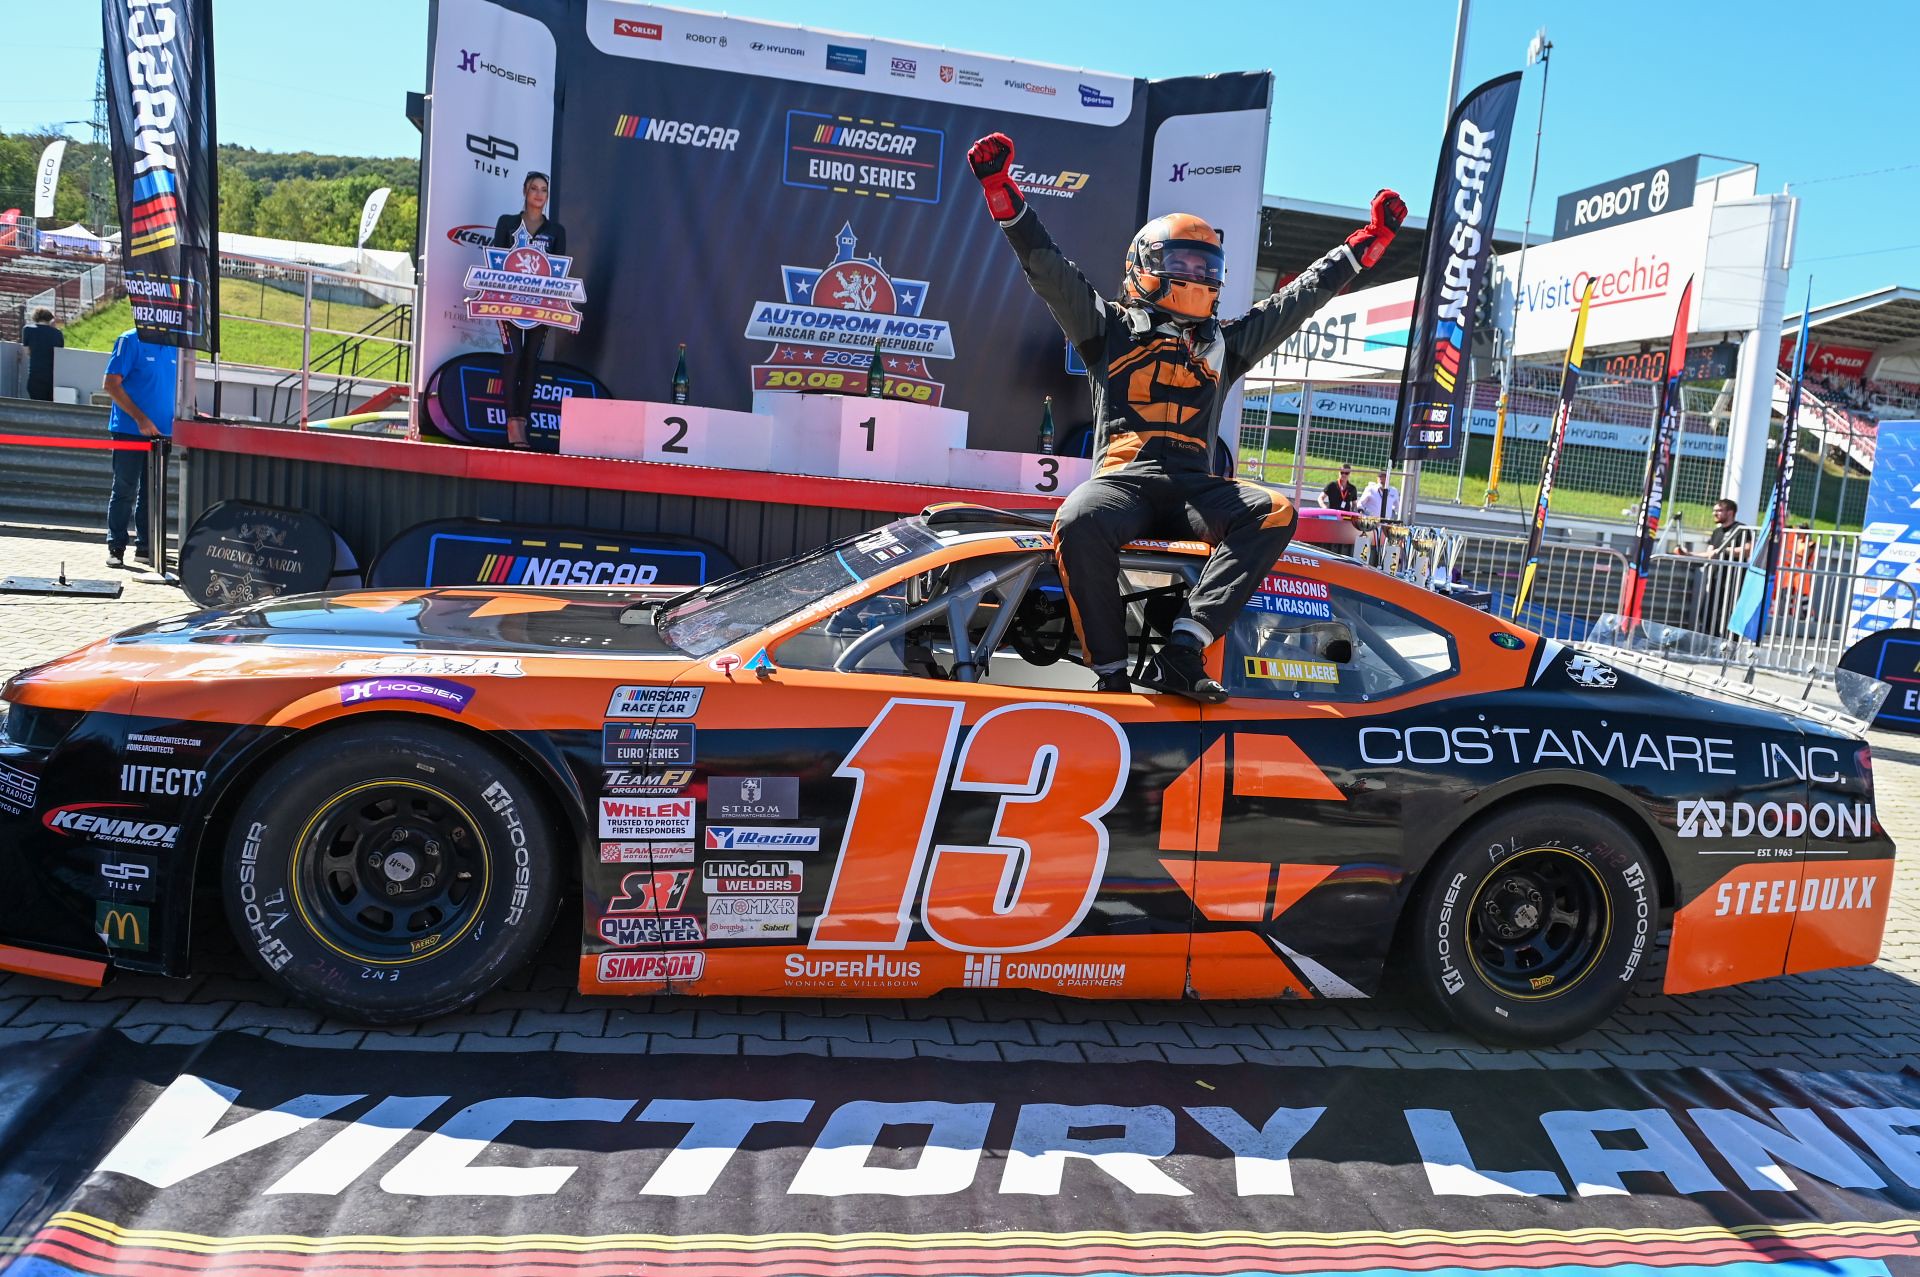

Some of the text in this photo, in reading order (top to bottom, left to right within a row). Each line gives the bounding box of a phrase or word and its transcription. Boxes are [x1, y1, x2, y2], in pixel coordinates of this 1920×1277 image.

[632, 26, 658, 36] ORLEN
[686, 33, 717, 45] ROBOT
[766, 45, 805, 57] HYUNDAI
[480, 61, 537, 87] HOOSIER
[891, 60, 917, 71] NEXEN
[1004, 79, 1057, 94] #VisitCzechia
[645, 118, 740, 151] NASCAR
[838, 128, 917, 155] NASCAR
[474, 159, 509, 179] TIJEY
[809, 159, 916, 191] EURO SERIES
[1188, 165, 1241, 176] HOOSIER
[42, 158, 54, 198] IVECO
[1017, 184, 1074, 199] GANIZATION
[1574, 182, 1645, 227] ROBOT
[1437, 118, 1495, 327] NASCAR
[454, 230, 494, 247] KEN
[473, 270, 579, 291] AUTODROM MOST
[1517, 254, 1670, 313] #VisitCzechia
[478, 281, 506, 290] NASCAR
[519, 285, 540, 293] CZECH
[541, 287, 573, 298] REPUBLIC
[509, 294, 543, 306] 2025
[478, 304, 523, 316] 30.08
[534, 309, 572, 323] 31.08
[756, 306, 946, 341] AUTODROM MOST
[767, 325, 934, 353] NASCAR GP CZECH REPUBLIC
[1835, 357, 1864, 368] ORLEN
[765, 371, 845, 388] 30.08
[533, 383, 573, 400] SCAR
[1339, 402, 1391, 416] HYUNDAI
[661, 416, 689, 455] 2
[859, 416, 876, 451] 1
[1571, 430, 1618, 441] HYUNDAI
[1035, 458, 1059, 493] 3
[1129, 540, 1207, 551] KRASONIS
[206, 545, 253, 565] FLORENCE
[256, 555, 264, 566] &
[266, 557, 304, 574] NARDIN
[522, 557, 659, 586] NASCAR
[1263, 577, 1328, 598] T. KRASONIS
[1264, 595, 1330, 618] T. KRASONIS
[1269, 663, 1337, 681] M. VAN LAERE
[377, 683, 464, 703] HOOSIER
[639, 690, 690, 702] NASCAR
[621, 703, 686, 713] RACE CAR
[128, 733, 202, 747] WWW.DIREARCHITECTS.COM
[633, 728, 679, 740] NASCAR
[126, 743, 174, 754] #DIREARCHITECTS
[617, 747, 680, 759] EURO SERIES
[1359, 725, 1847, 785] COSTAMARE INC.
[6, 786, 33, 803] RADIOS
[602, 800, 691, 818] WHELEN
[721, 805, 780, 813] STROM
[51, 811, 180, 843] KENNOL
[807, 697, 1131, 953] 13
[1732, 802, 1872, 839] DODONI
[93, 833, 175, 849] PERFORMANCE OIL
[736, 832, 817, 847] iRacing
[623, 847, 694, 855] SAMSONAS
[1757, 849, 1793, 857] EST. 1963
[500, 806, 530, 926] HOOSIER
[708, 862, 785, 878] LINCOLN
[108, 881, 142, 892] TIJEY
[240, 822, 271, 945] HOOSIER
[725, 880, 792, 891] WELDERS
[1714, 876, 1877, 918] STEELDUXX
[709, 899, 795, 915] ATOMIX-R
[601, 918, 695, 938] QUARTER
[762, 923, 790, 932] Sabelt
[1438, 872, 1468, 973] HOOSIER
[619, 929, 699, 945] MASTER
[1618, 885, 1648, 983] HOOSIER
[415, 936, 436, 950] AERO
[605, 955, 692, 978] SIMPSON
[1006, 963, 1126, 980] CONDOMINIUM
[1067, 978, 1124, 986] PARTNERS
[1534, 976, 1552, 987] AERO
[97, 1074, 1327, 1197] VICTORY
